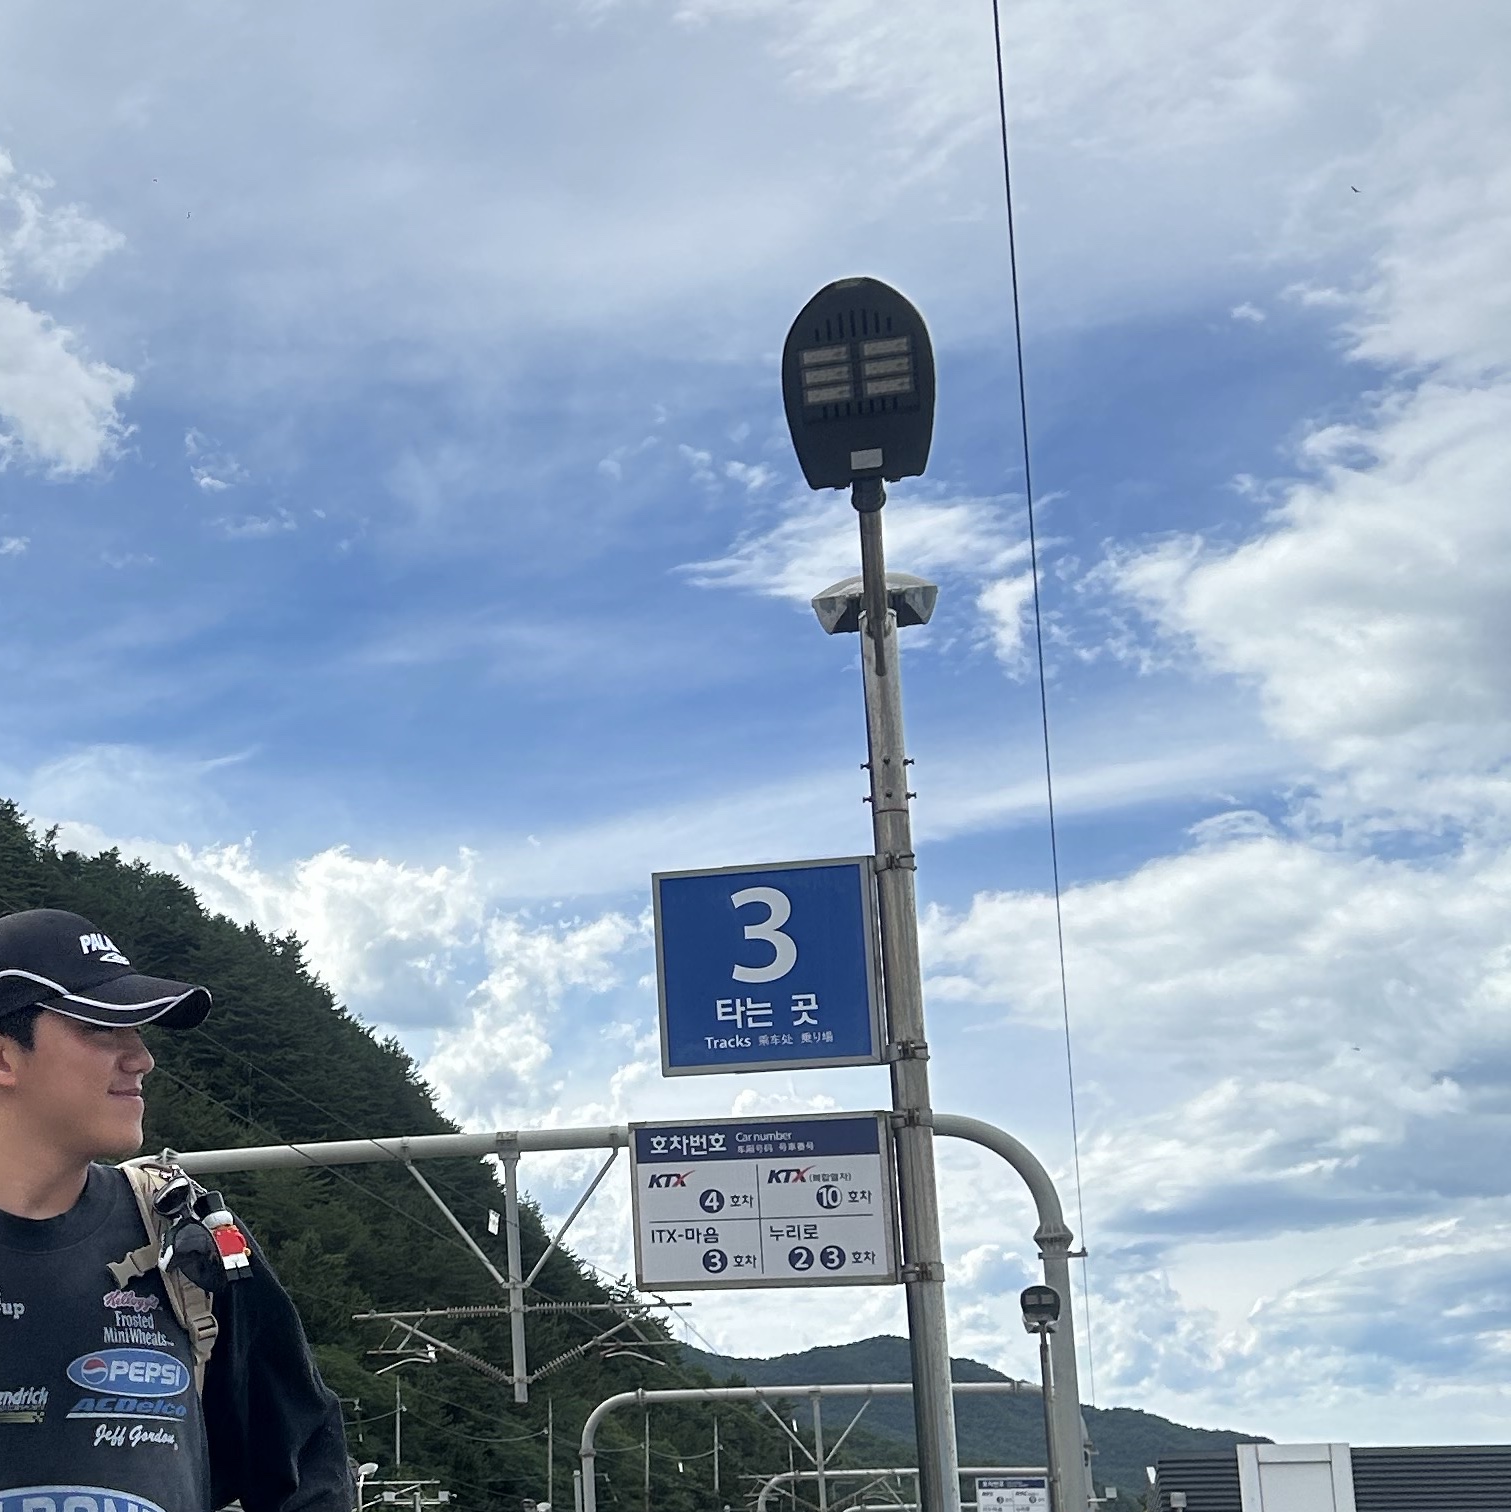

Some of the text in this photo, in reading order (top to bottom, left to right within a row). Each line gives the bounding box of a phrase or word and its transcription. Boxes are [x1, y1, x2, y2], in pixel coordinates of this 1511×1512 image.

[730, 886, 798, 984] 3
[715, 993, 819, 1029] 타는 곳
[704, 1034, 752, 1050] Tracks
[650, 1133, 728, 1156] 호차번호
[735, 1130, 793, 1143] Car number
[648, 1170, 695, 1188] KTX
[767, 1165, 816, 1184] KTX
[703, 1190, 754, 1212] 4 호차
[818, 1186, 872, 1207] 10 호차
[651, 1226, 719, 1245] ITX-마음
[769, 1223, 819, 1241] 누리로
[707, 1249, 757, 1272] 3 호차
[793, 1247, 876, 1269] 2 3 호차
[115, 1310, 155, 1329] Frosted
[109, 1360, 181, 1387] PEPSI
[70, 1397, 187, 1417] ACDelco
[93, 1424, 175, 1448] Jeff Gordon
